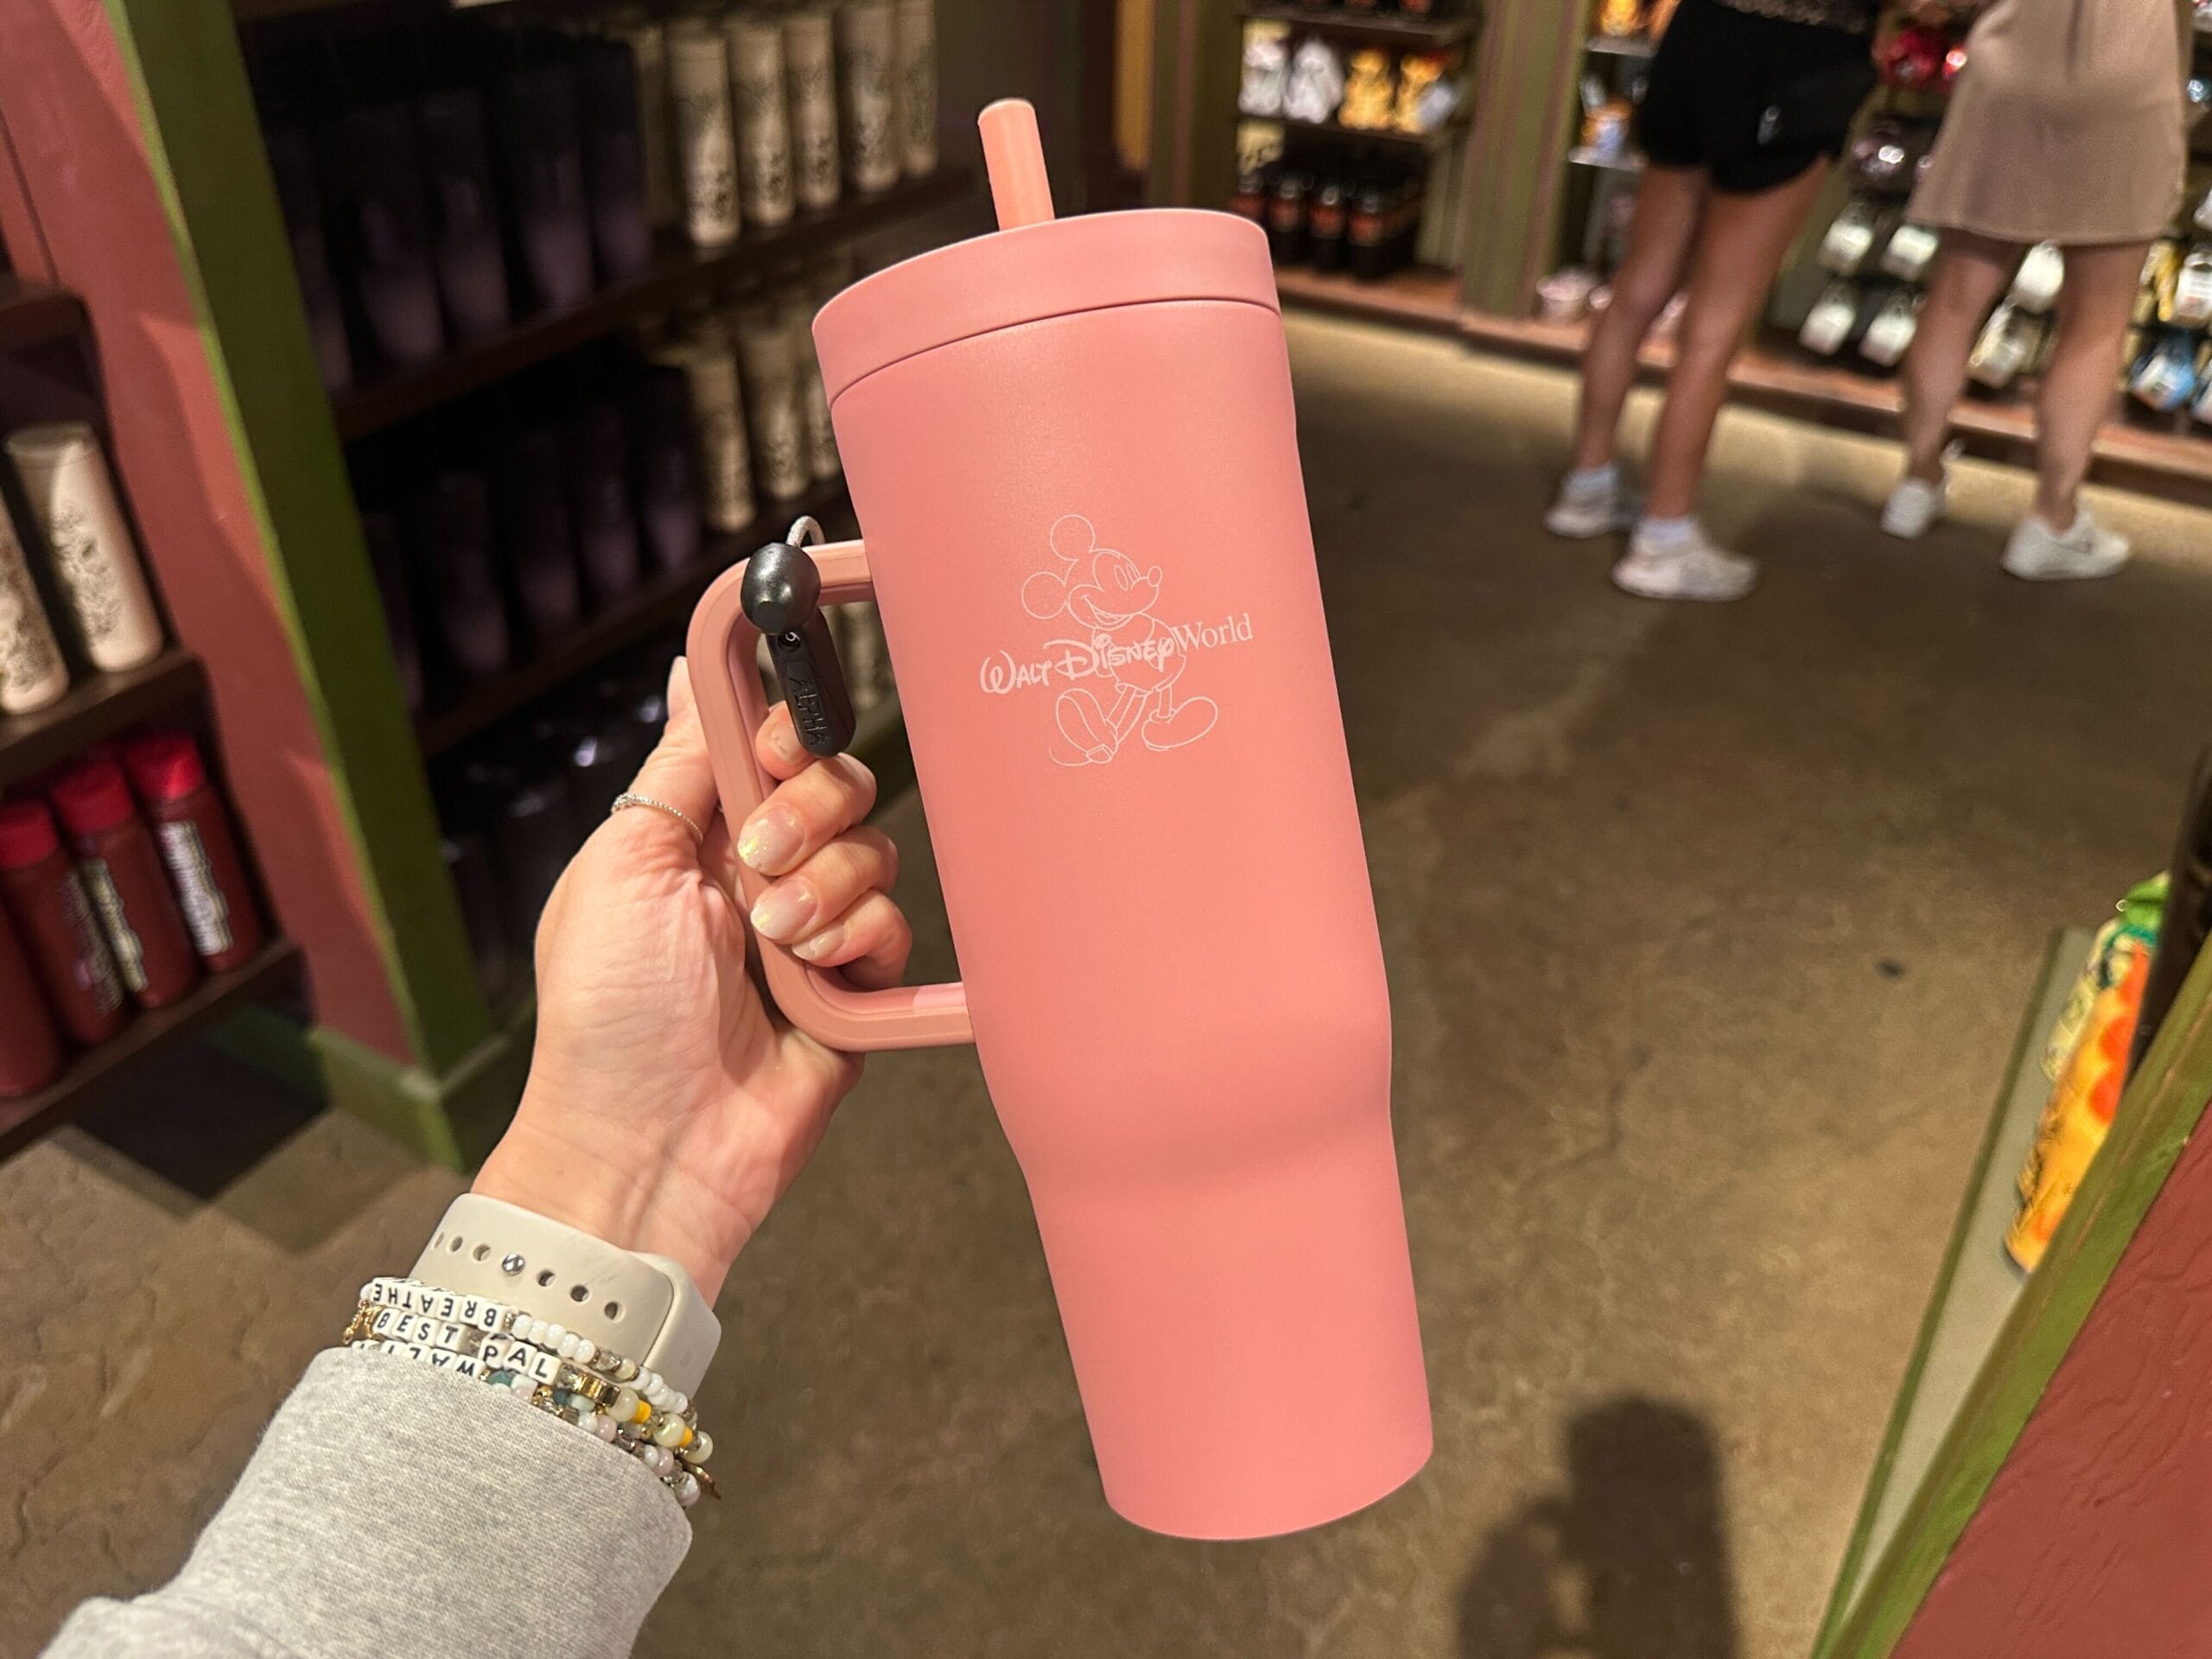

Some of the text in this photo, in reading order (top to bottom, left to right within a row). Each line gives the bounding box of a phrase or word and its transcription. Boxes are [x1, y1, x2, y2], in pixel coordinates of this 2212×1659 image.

[1171, 613, 1255, 652] World
[372, 1283, 497, 1327] BREATHE
[377, 1312, 551, 1376] BEST PAL
